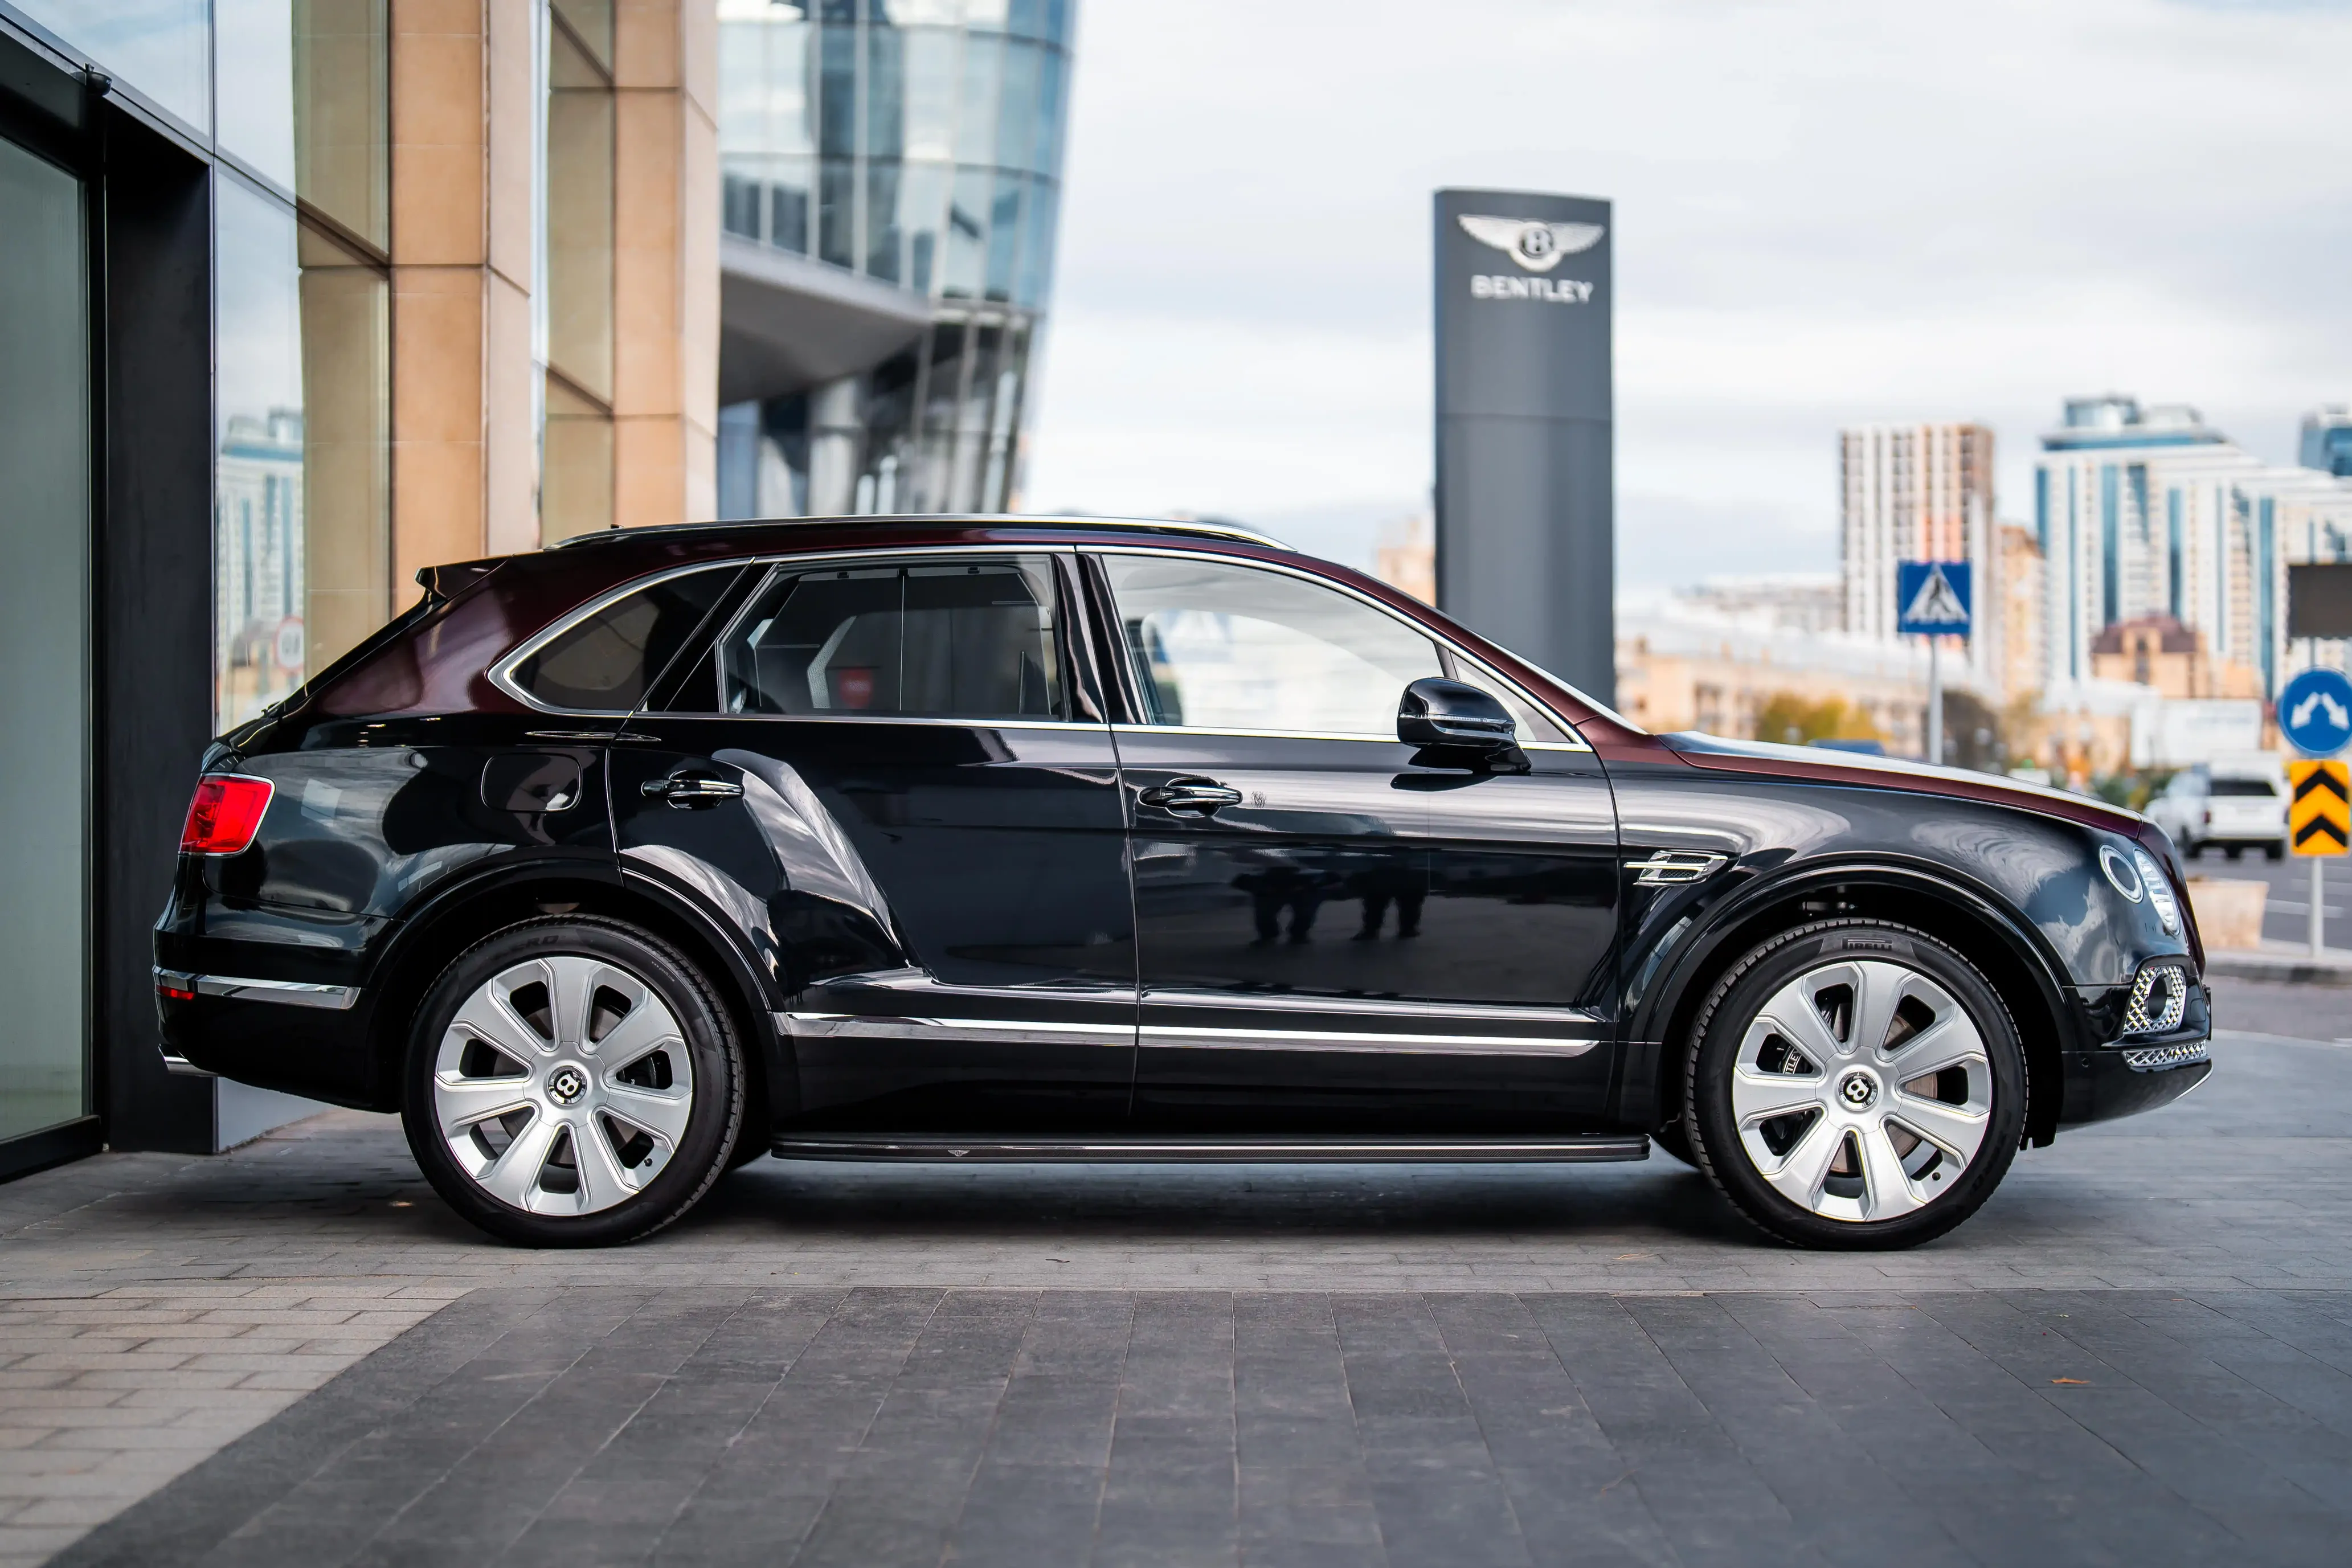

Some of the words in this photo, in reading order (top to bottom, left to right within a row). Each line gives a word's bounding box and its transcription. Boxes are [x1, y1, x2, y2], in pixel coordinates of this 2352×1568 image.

[1471, 275, 1593, 304] BENTLEY
[1842, 937, 1893, 951] PIRELLI
[557, 1074, 579, 1096] B
[1846, 1079, 1869, 1101] B
